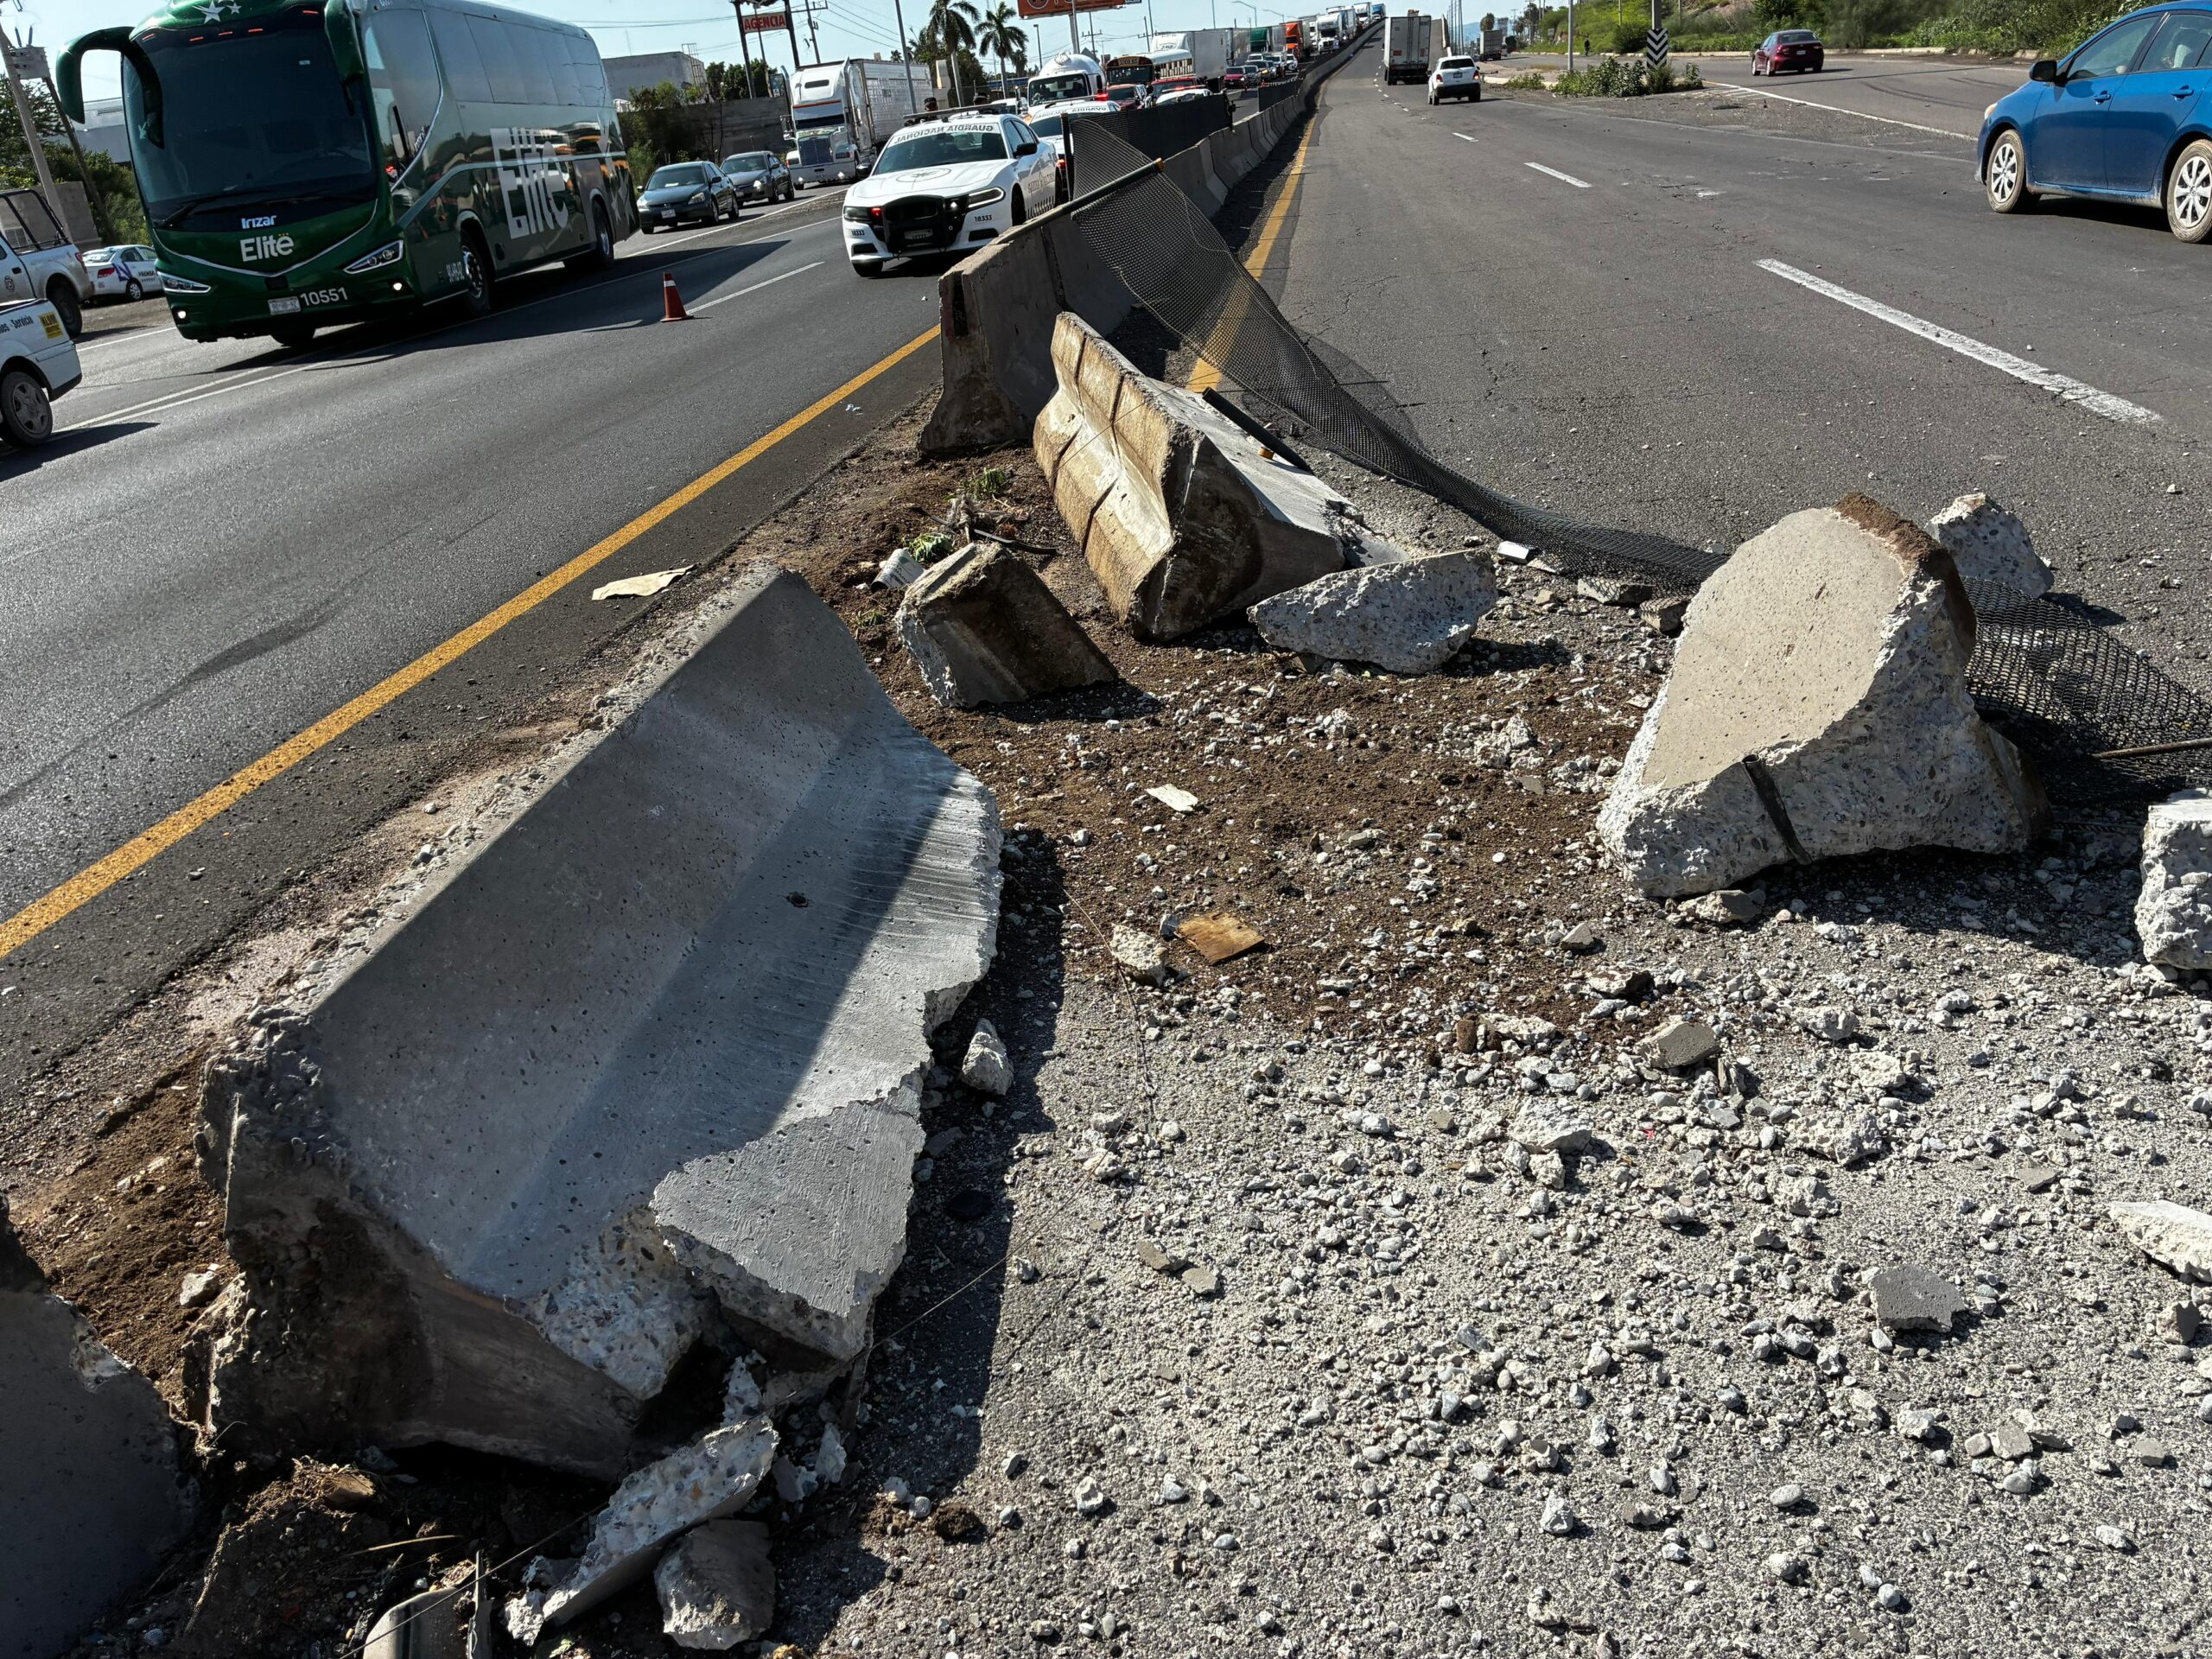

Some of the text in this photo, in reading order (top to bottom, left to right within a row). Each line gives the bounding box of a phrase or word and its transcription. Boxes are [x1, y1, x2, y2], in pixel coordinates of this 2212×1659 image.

[745, 15, 786, 30] AGENCIA
[490, 126, 569, 239] Elite
[240, 234, 295, 263] Elite
[300, 286, 348, 307] 10551
